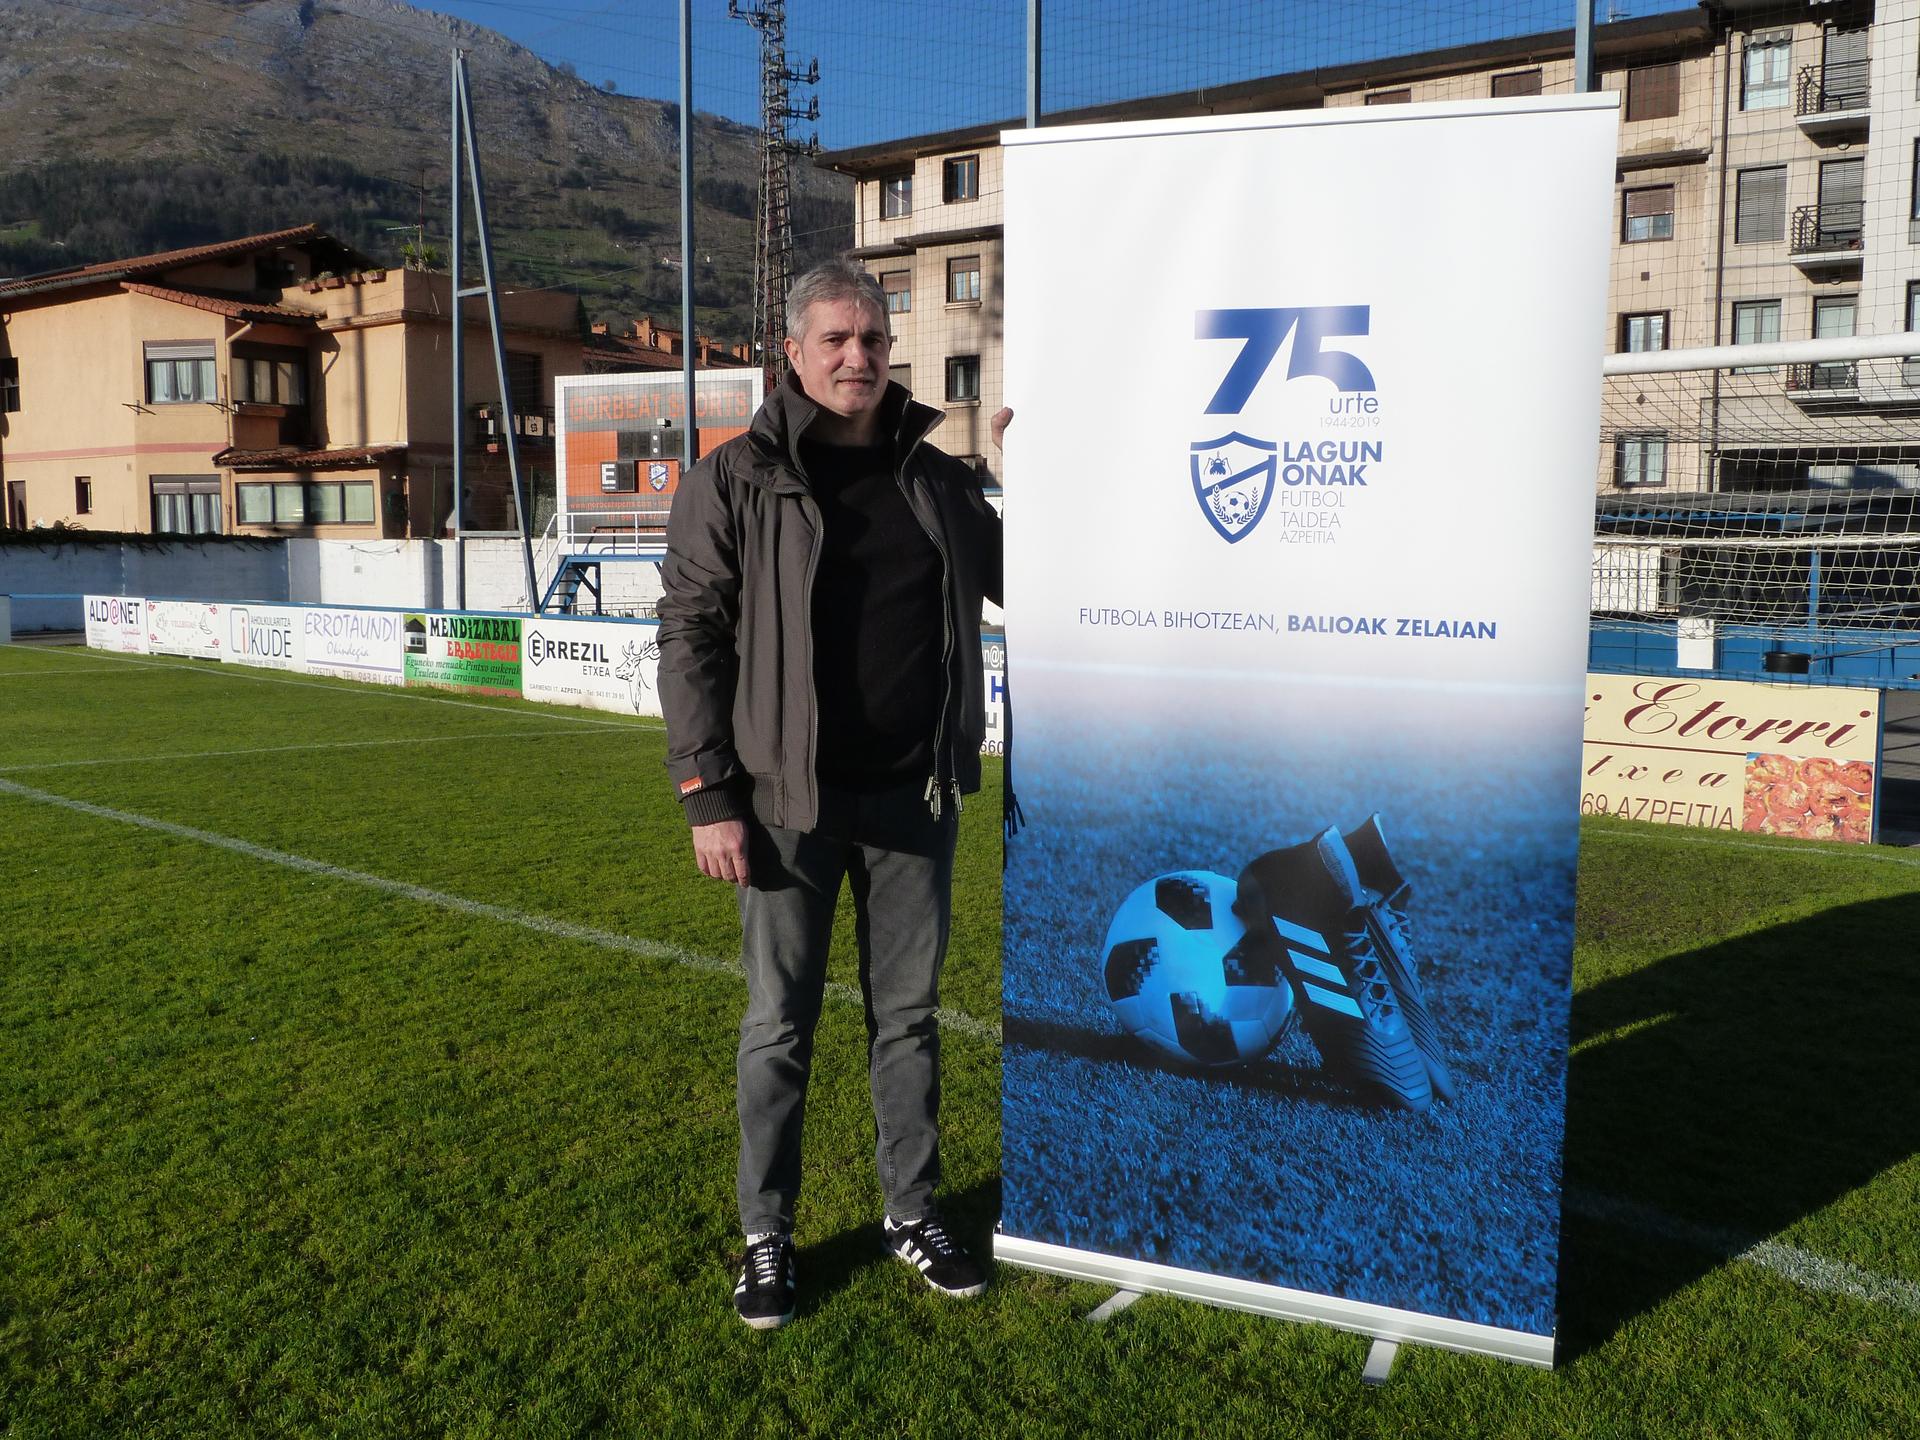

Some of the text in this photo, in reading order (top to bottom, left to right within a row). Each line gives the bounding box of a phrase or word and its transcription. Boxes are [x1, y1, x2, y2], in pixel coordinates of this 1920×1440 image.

[1194, 304, 1377, 415] 75
[1329, 392, 1379, 414] urte
[1319, 416, 1381, 428] 1944-2019
[1283, 440, 1383, 463] LAGUN
[1282, 464, 1368, 487] ONAK
[1281, 490, 1345, 508] FUTBOL
[1280, 511, 1342, 529] TALDEA
[1279, 530, 1336, 545] AZPEITIA
[89, 598, 140, 626] ALD@NET
[1079, 607, 1497, 640] FUTBOLA BIHOTZEAN, BALIOAK ZELAIAN
[304, 611, 397, 642] ERROTAUNDI
[405, 655, 434, 669] Eguneko
[532, 639, 610, 664] ERREZIL
[413, 667, 514, 688] Txuleta eta arraina parrillan
[582, 665, 611, 678] ETXEA
[1623, 681, 1874, 749] Etorri
[1616, 795, 1734, 830] AZPEITIA
